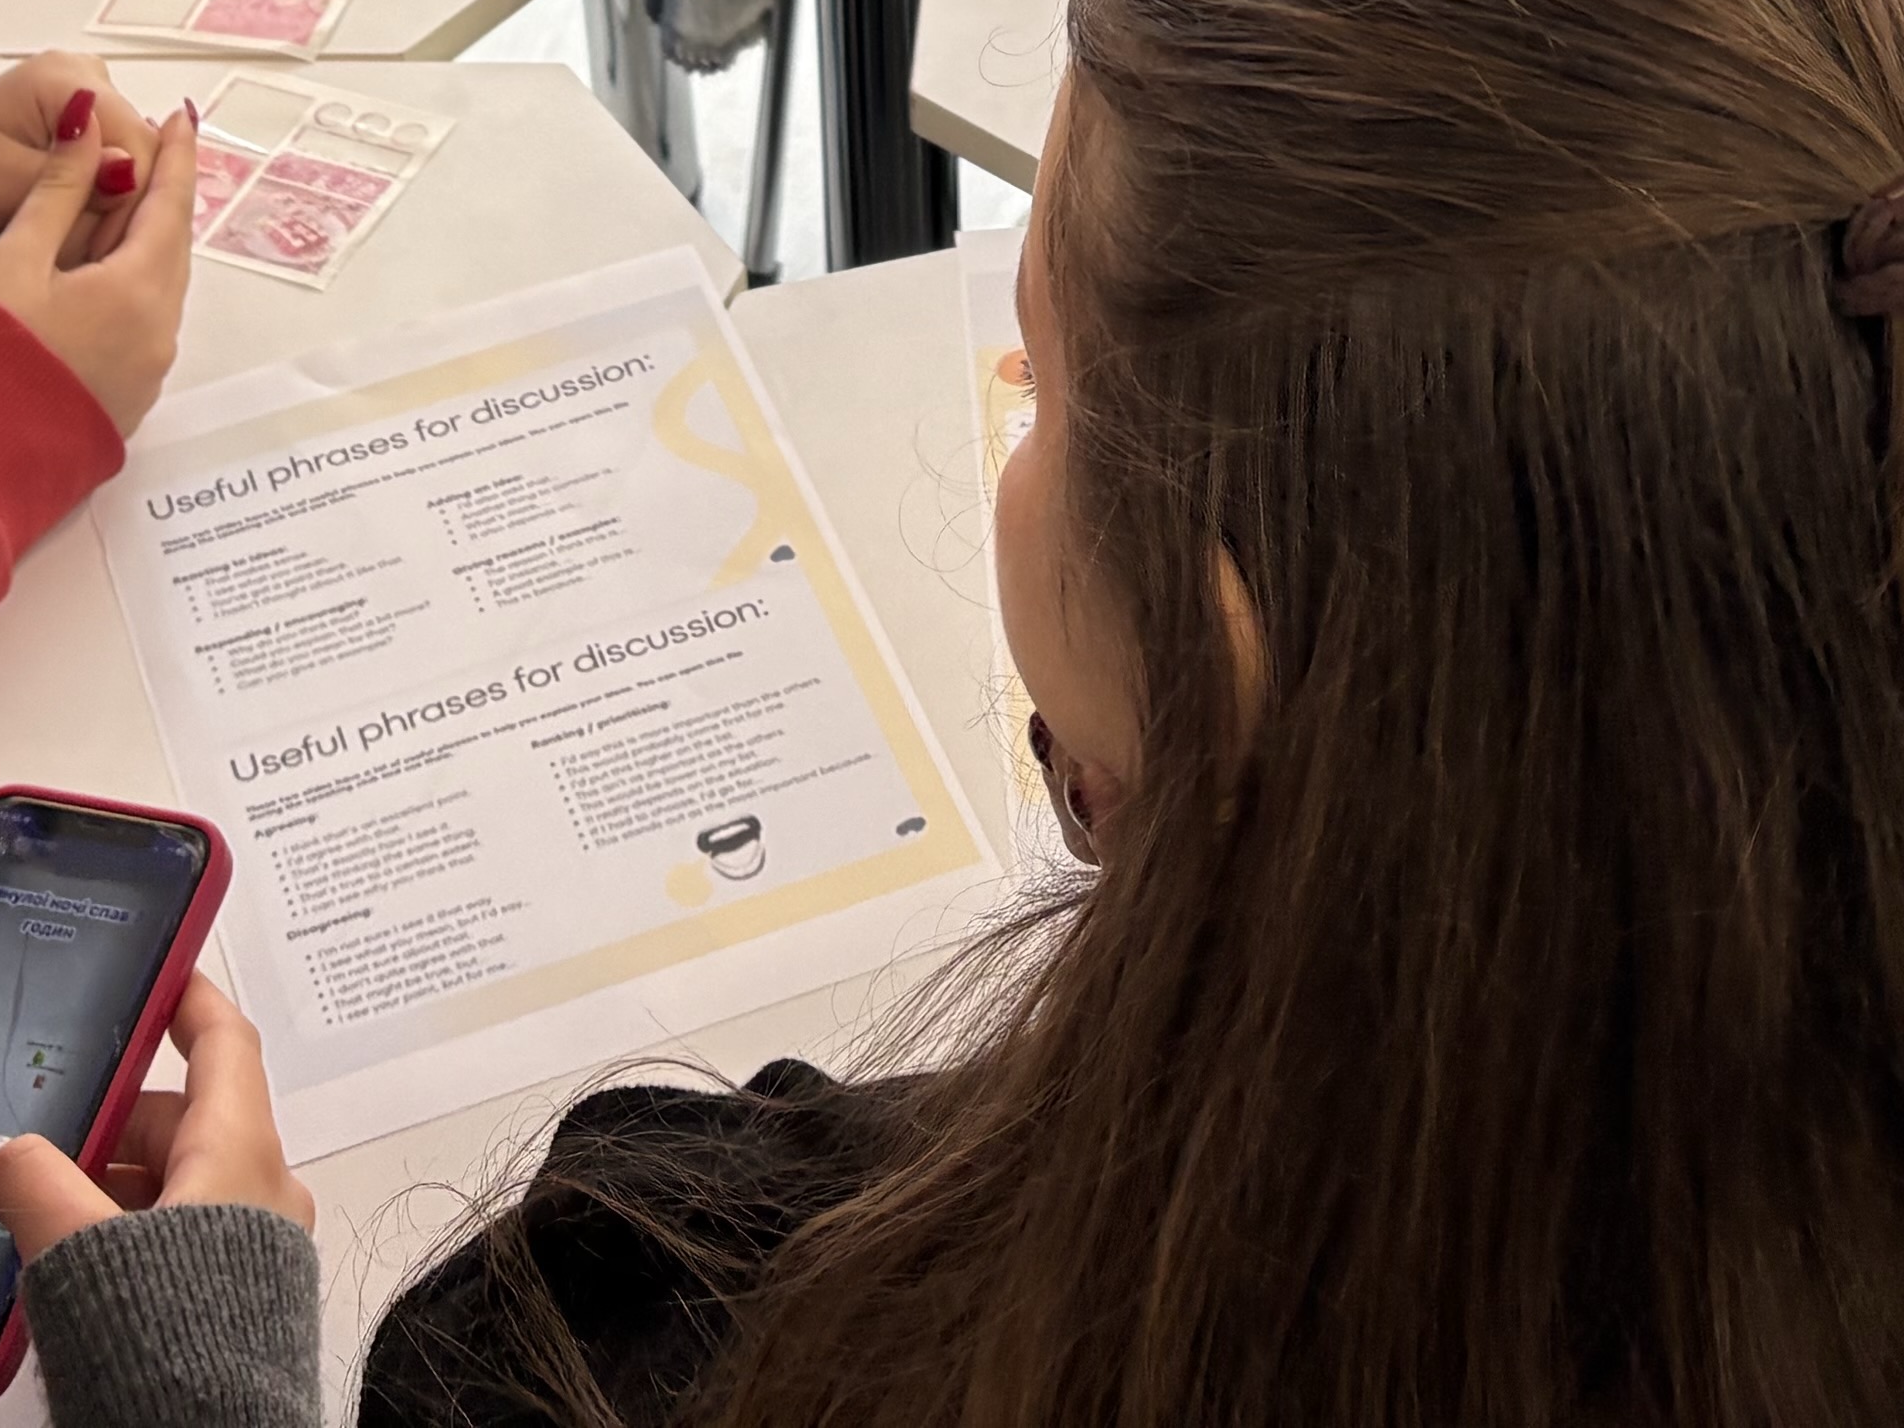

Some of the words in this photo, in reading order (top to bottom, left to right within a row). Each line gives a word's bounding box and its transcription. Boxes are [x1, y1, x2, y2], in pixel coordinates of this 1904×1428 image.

[145, 468, 258, 520] Useful
[266, 431, 409, 492] phrases
[413, 413, 461, 442] for
[469, 354, 655, 424] discussion:
[228, 724, 348, 782] Useful
[357, 681, 508, 751] phrases
[512, 660, 563, 693] for
[572, 598, 769, 673] discussion:
